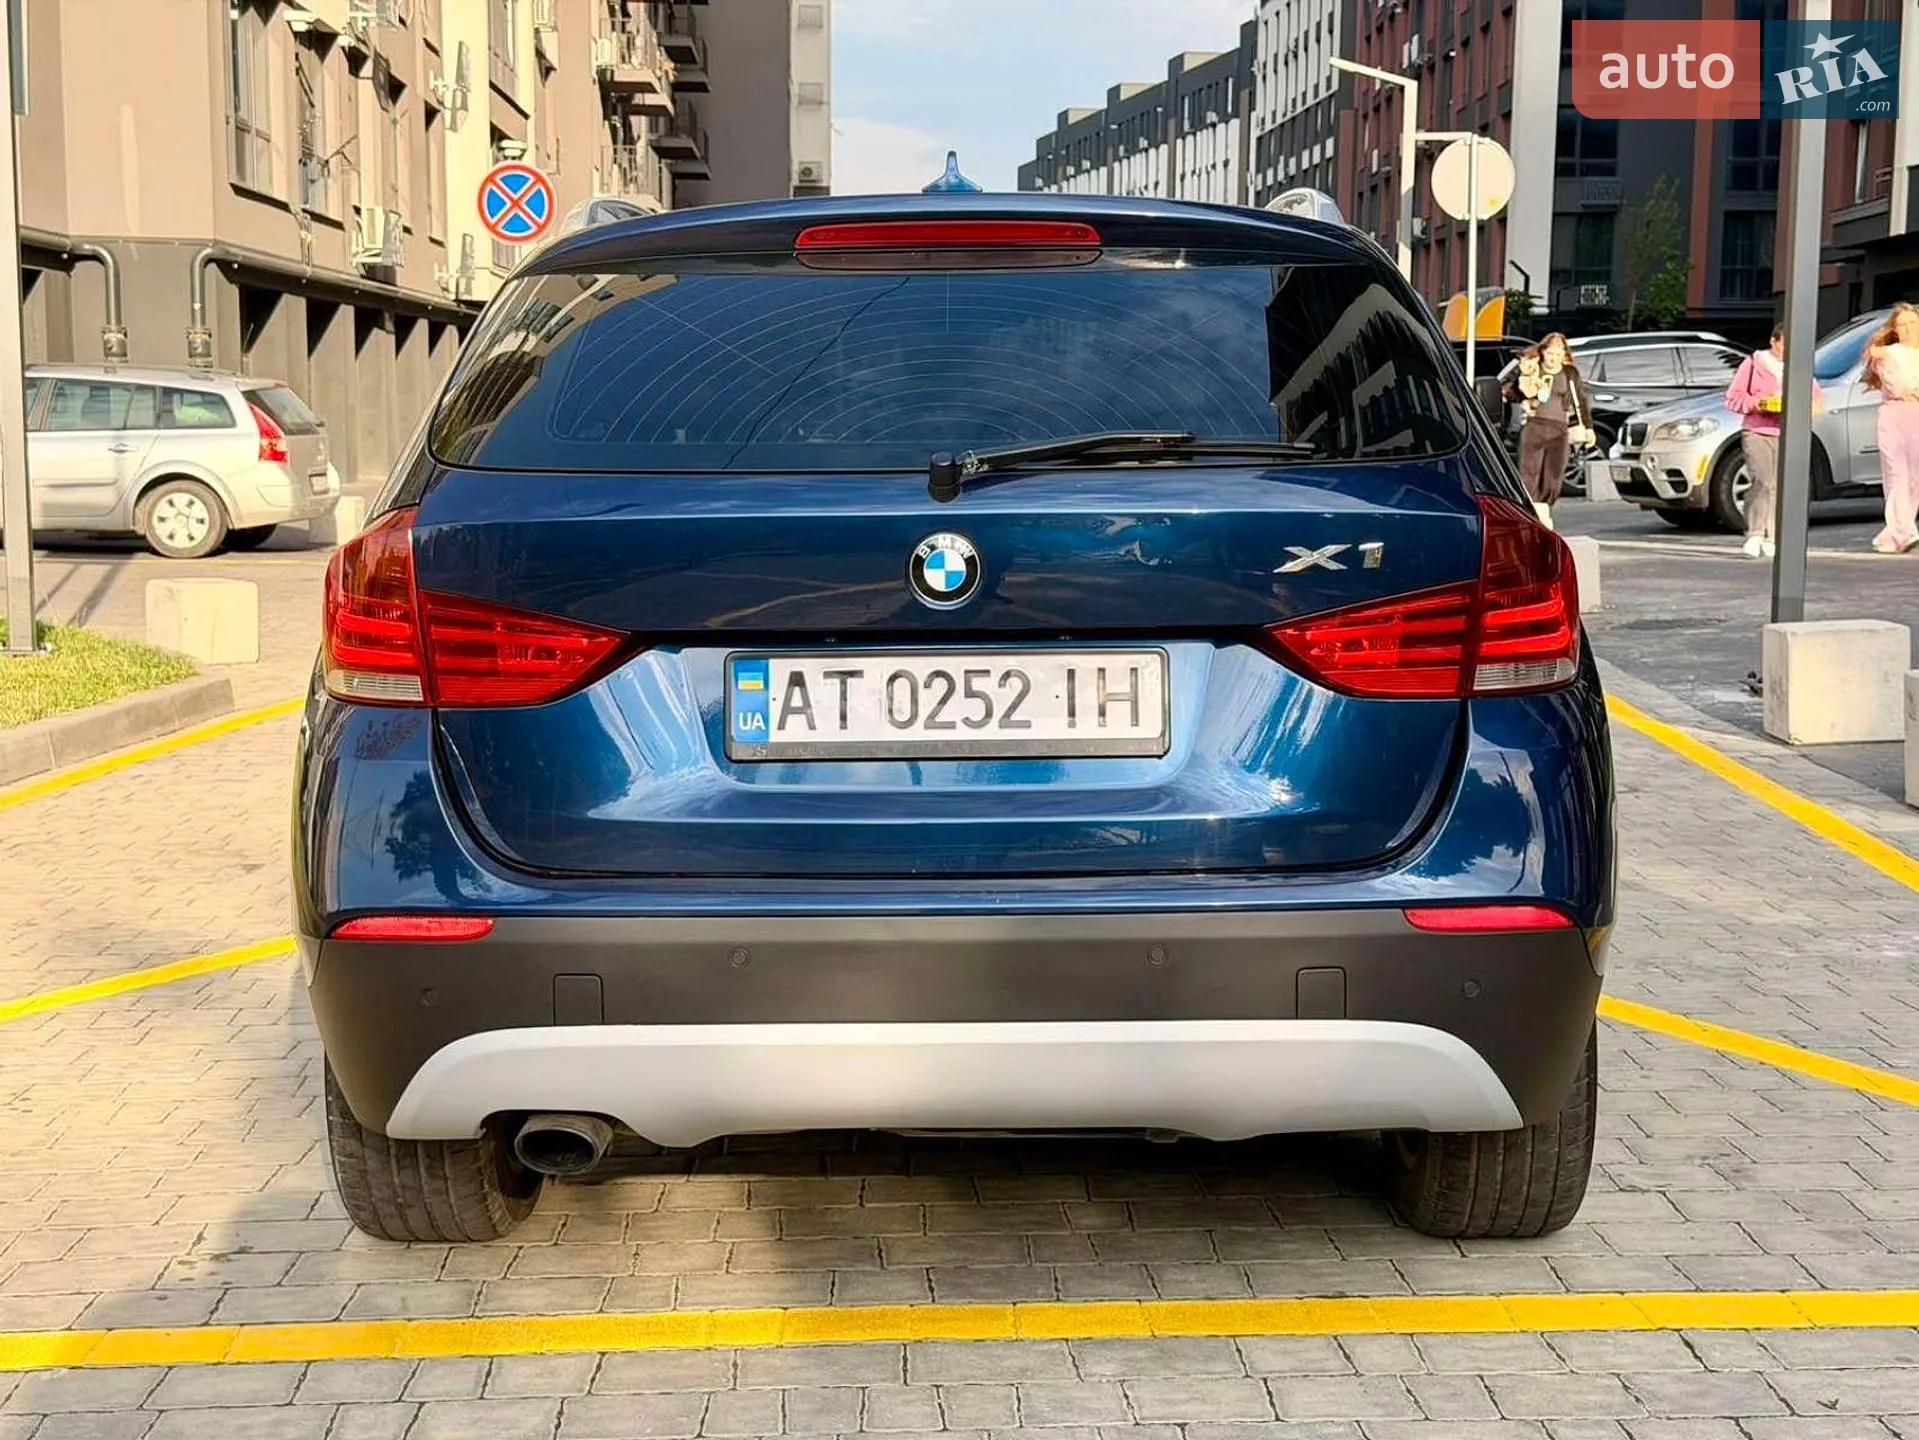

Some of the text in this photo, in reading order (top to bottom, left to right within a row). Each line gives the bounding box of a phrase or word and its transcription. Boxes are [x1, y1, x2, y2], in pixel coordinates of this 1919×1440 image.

[918, 534, 975, 559] BMW
[1272, 542, 1385, 573] X1
[776, 666, 1140, 731] AT 0252 IH
[739, 713, 765, 731] UA
